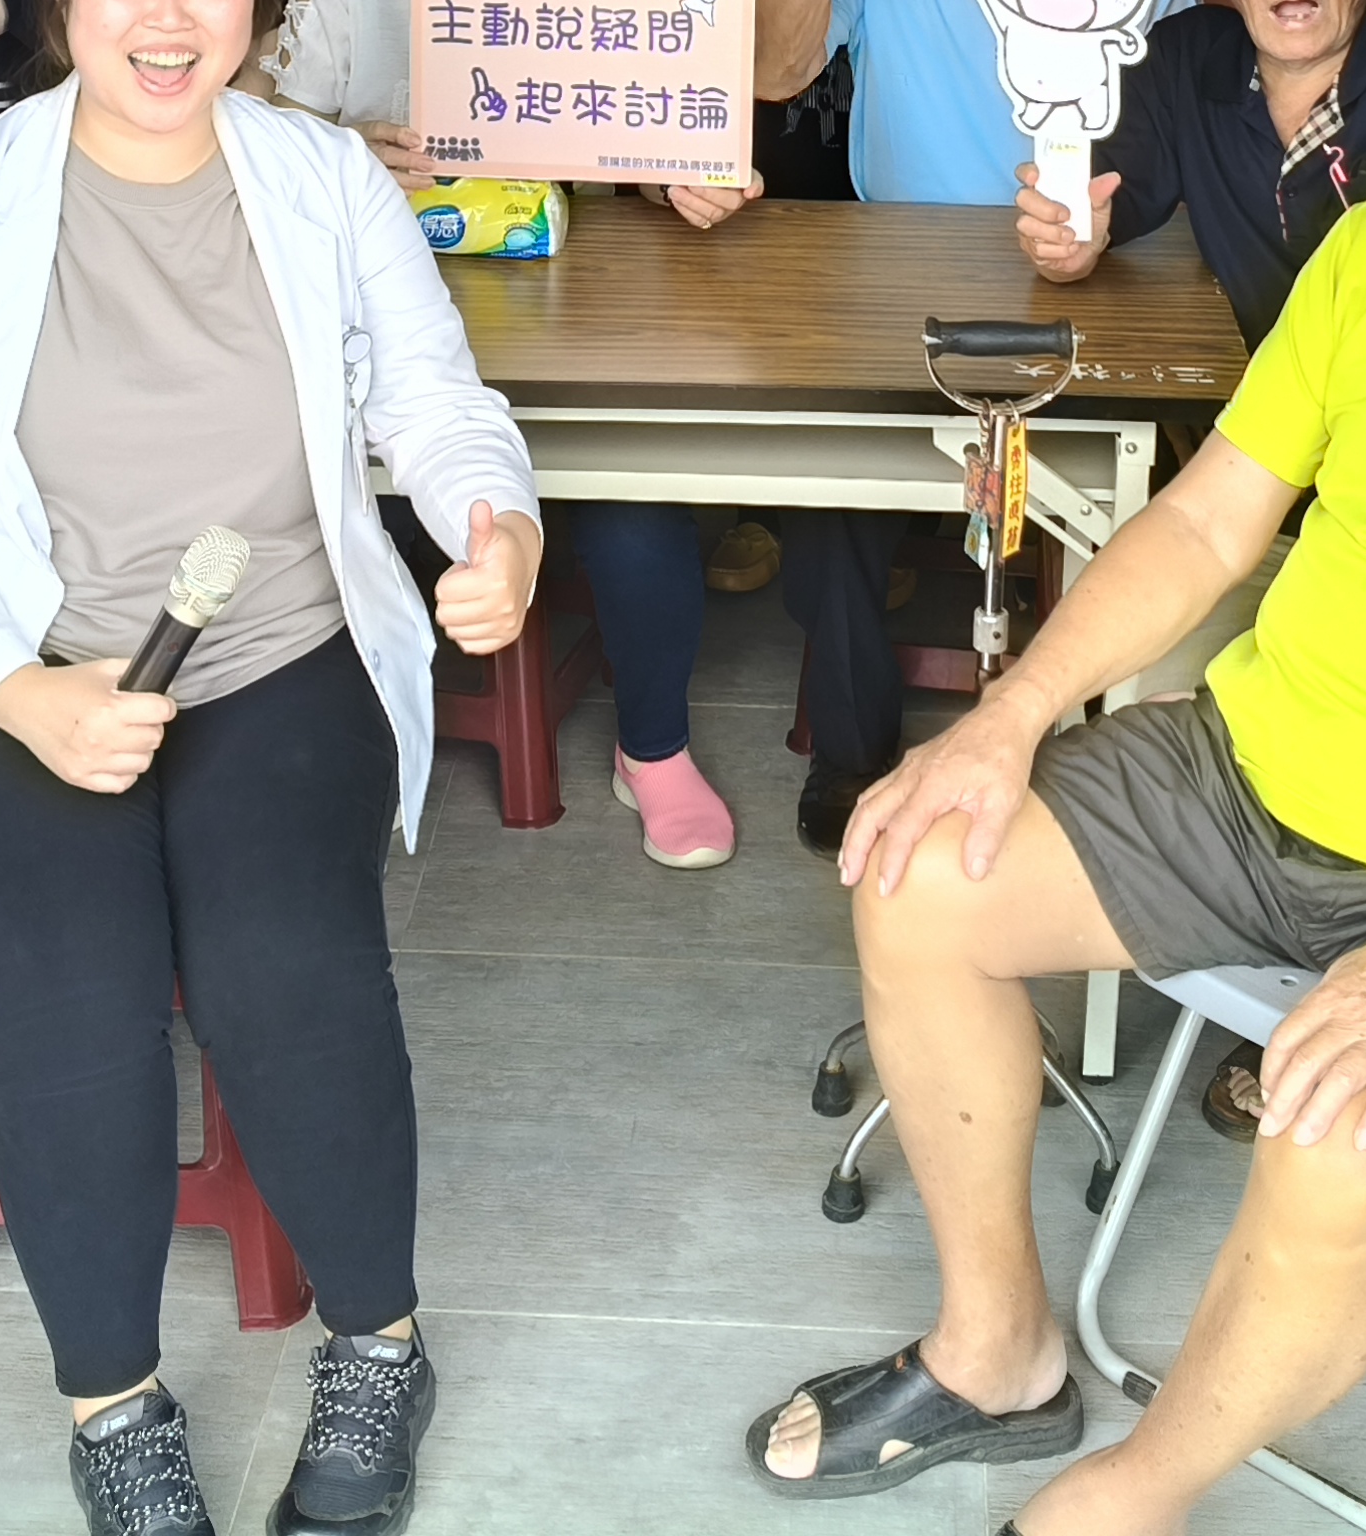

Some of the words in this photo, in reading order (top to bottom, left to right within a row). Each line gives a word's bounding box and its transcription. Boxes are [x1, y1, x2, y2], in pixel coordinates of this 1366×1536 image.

[515, 76, 730, 131] 起來討論
[597, 154, 736, 173] 別讓您的沉默成為病安殺手
